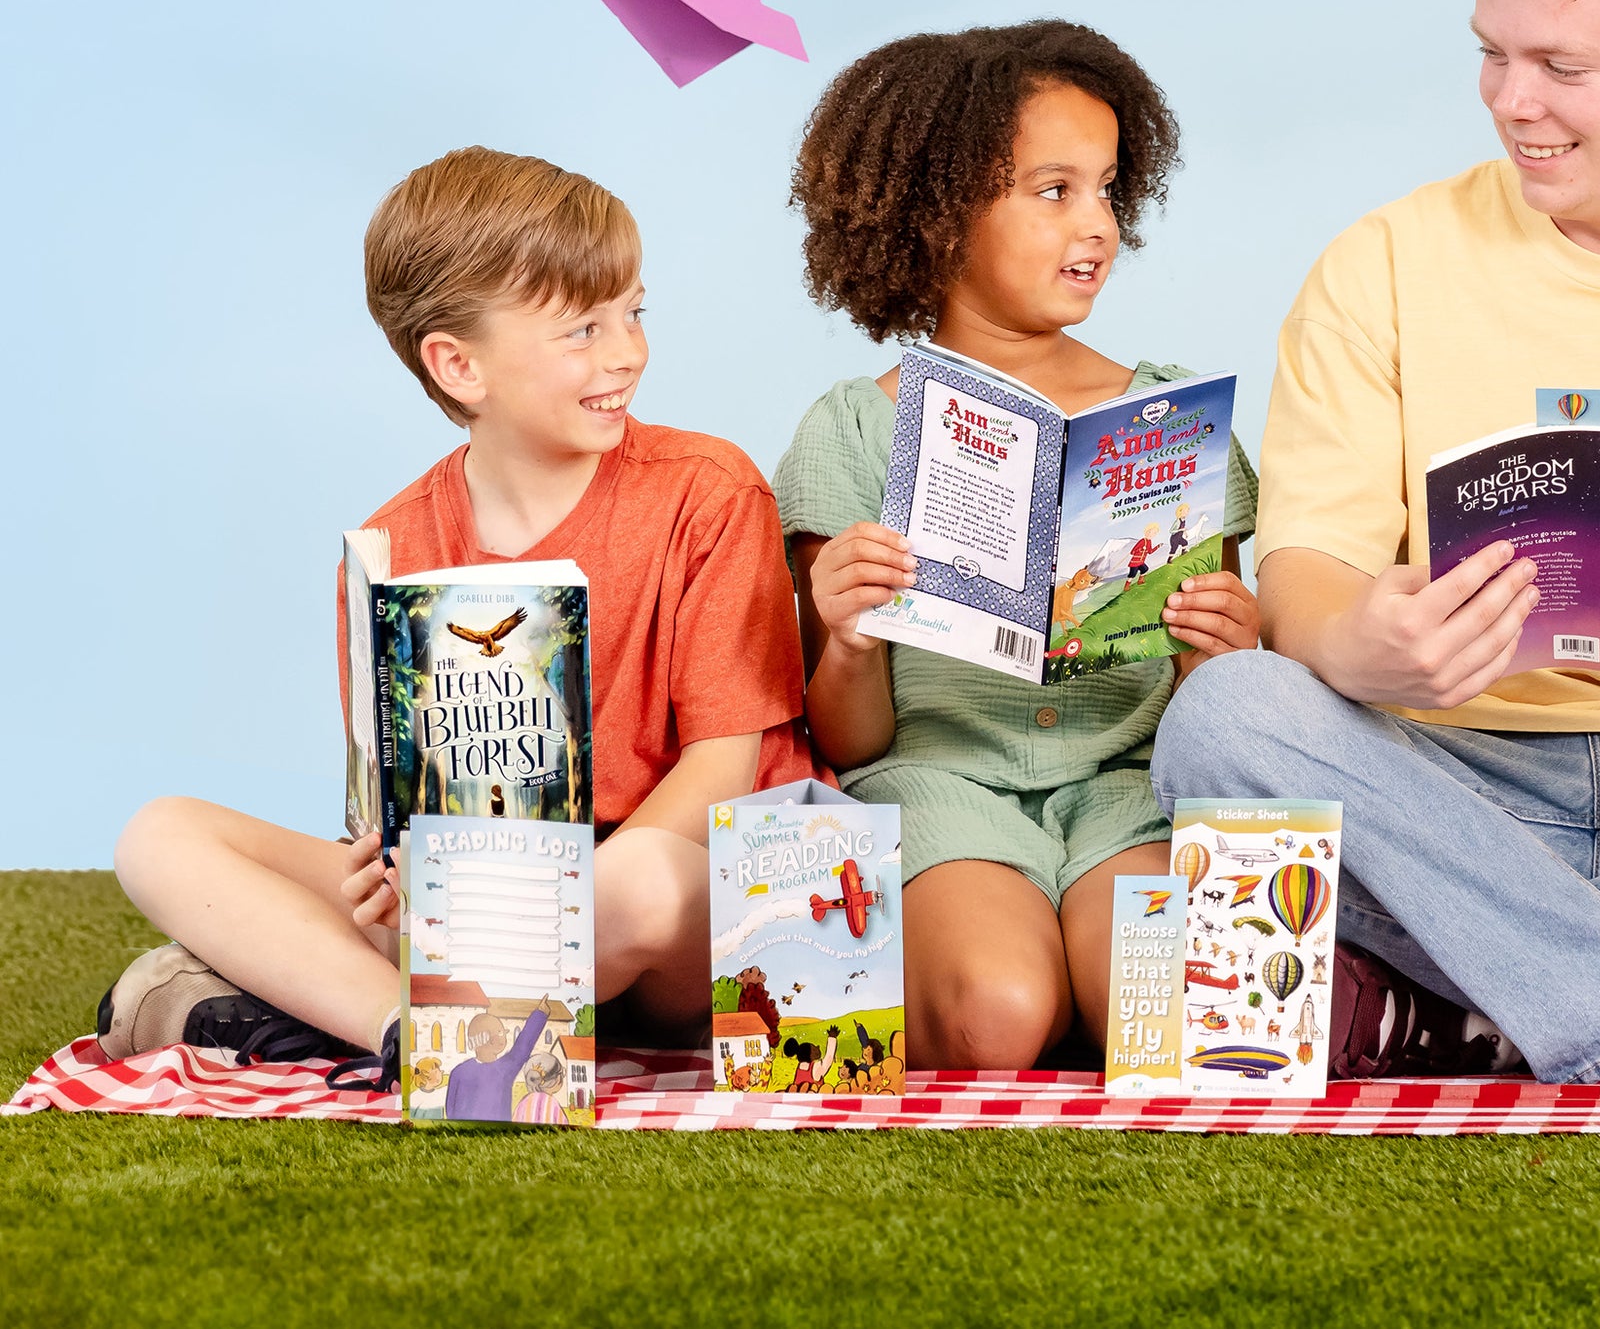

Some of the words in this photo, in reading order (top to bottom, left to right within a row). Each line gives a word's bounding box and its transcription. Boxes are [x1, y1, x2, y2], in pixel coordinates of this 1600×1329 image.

[944, 398, 988, 430] Ann
[991, 426, 1010, 436] and
[951, 421, 1009, 460] Hans
[1090, 429, 1164, 467] Ann
[1168, 420, 1201, 444] and
[1498, 453, 1527, 469] THE
[1102, 453, 1198, 500] Hans
[1457, 458, 1575, 504] KINGDOM
[1114, 499, 1123, 508] of
[1124, 494, 1137, 504] the
[1138, 489, 1162, 501] Swiss
[1162, 483, 1181, 495] Alps
[1463, 498, 1480, 512] OF
[1482, 477, 1567, 511] STARS
[1507, 534, 1529, 543] hance
[1520, 540, 1534, 548] you
[1535, 537, 1551, 545] take
[376, 598, 386, 615] 5
[457, 594, 493, 604] ISABELLE
[496, 594, 515, 604] DIBB
[906, 610, 953, 633] Beautiful
[1104, 630, 1128, 642] Jenny
[1131, 622, 1164, 635] Phillips
[435, 657, 458, 671] THE
[431, 661, 524, 705] LEGEND
[473, 696, 485, 705] OF
[420, 697, 563, 750] BLUEBELL
[435, 730, 567, 782] FOREST
[1216, 808, 1255, 821] Sticker
[1257, 809, 1289, 821] Sheet
[426, 831, 527, 854] READING
[536, 834, 580, 861] LOG
[742, 830, 800, 855] SUMMER
[736, 829, 874, 888] READING
[772, 868, 830, 892] PROGRAM
[1120, 922, 1178, 939] Choose
[739, 942, 766, 964] Choose
[766, 933, 791, 945] books
[793, 933, 813, 945] that
[813, 941, 835, 956] make
[836, 951, 853, 960] you
[854, 948, 867, 959] fly
[868, 931, 896, 953] higher!
[1121, 940, 1174, 959] books
[1121, 959, 1171, 980] that
[1119, 980, 1173, 998] make
[1119, 998, 1169, 1021] you
[1120, 1021, 1163, 1052] fly
[1113, 1048, 1176, 1069] higher!
